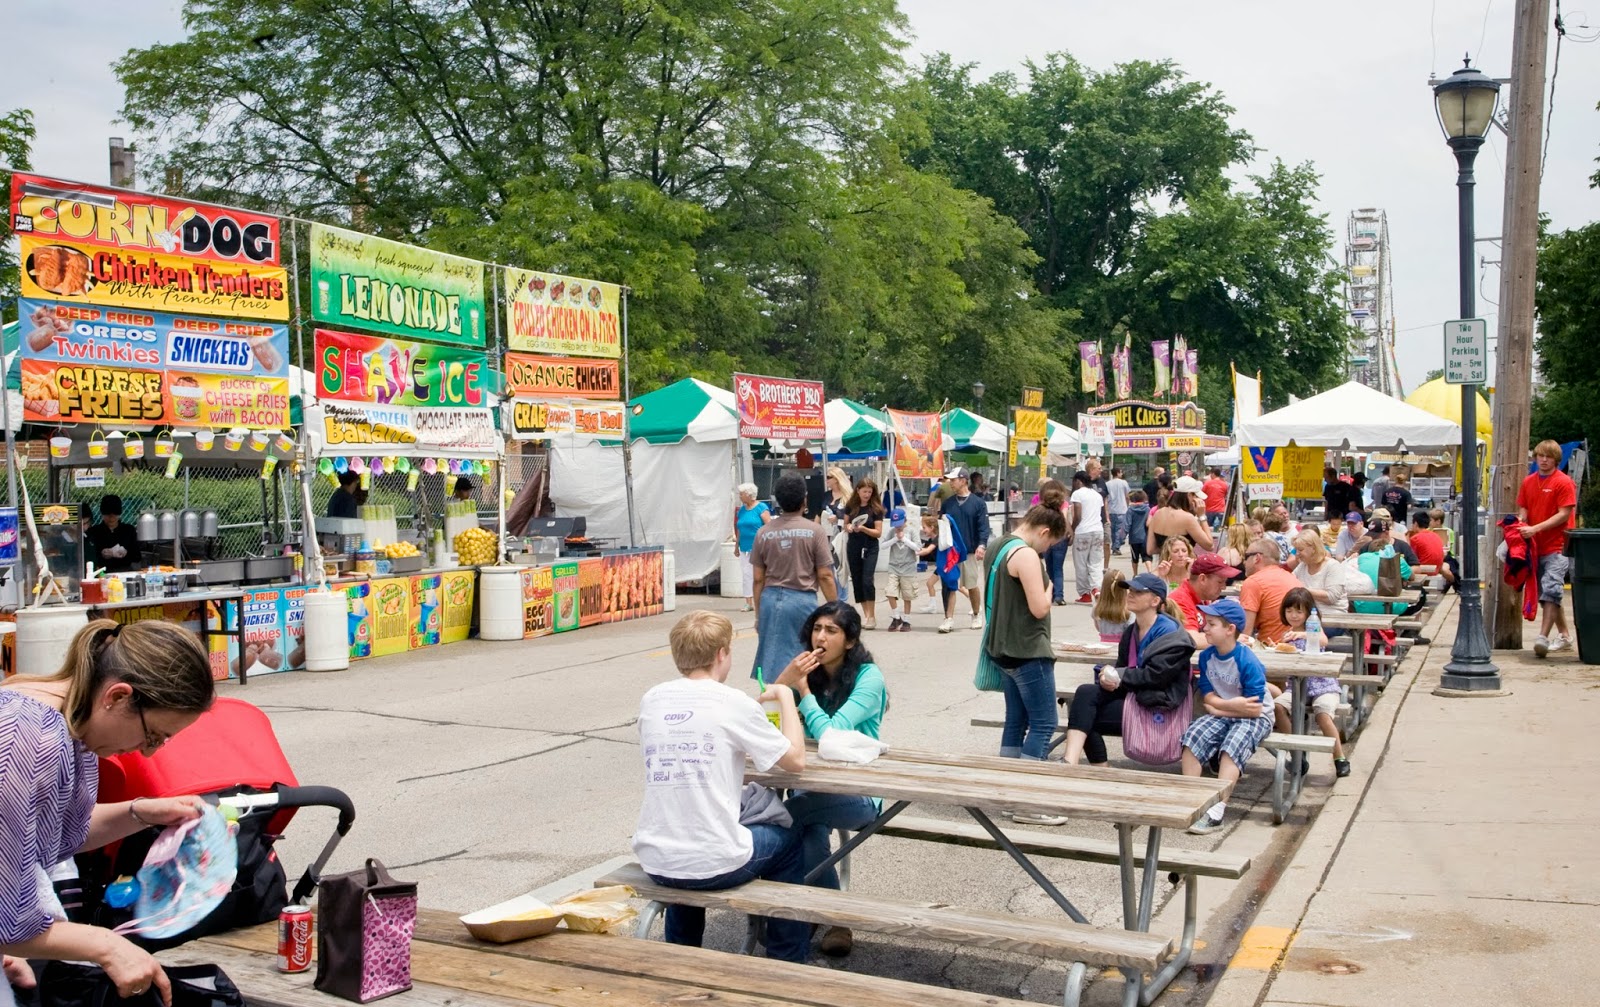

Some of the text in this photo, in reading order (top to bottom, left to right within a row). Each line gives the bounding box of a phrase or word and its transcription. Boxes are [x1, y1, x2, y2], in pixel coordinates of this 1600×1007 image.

[20, 195, 273, 261] CORN DOG
[374, 251, 434, 279] fresh squeezed
[93, 251, 284, 300] Chicken Tenders
[106, 280, 271, 310] With French Fries
[508, 273, 526, 308] JUMBO
[339, 273, 463, 336] LEMONADE
[55, 305, 154, 327] DEEP FRIED
[546, 304, 578, 340] CHICKEN
[579, 308, 590, 342] ON
[75, 324, 157, 342] OREOS
[173, 318, 275, 337] DEEP FRIED
[1459, 324, 1471, 332] Two
[1456, 336, 1474, 344] Hour
[53, 336, 159, 364] Twinkies
[171, 336, 250, 366] SNICKERS
[1452, 347, 1479, 356] Parking
[55, 366, 161, 398] CHEESE
[322, 346, 482, 405] SHAVE ICE
[512, 362, 613, 391] ORANGE CHICKEN
[1449, 371, 1463, 380] Mon
[1471, 371, 1483, 379] Sat
[220, 379, 271, 392] BUCKET OF
[59, 390, 164, 420] FRIES
[205, 391, 287, 409] CHEESE FRIES
[760, 383, 803, 405] BROTHERS'
[804, 387, 822, 410] BBQ
[209, 407, 284, 426] with BACON
[324, 404, 408, 425] Chocolate FROZEN
[416, 411, 462, 430] CHOCOLATE
[514, 402, 547, 430] CRAB
[574, 409, 623, 433] Egg Roll
[1136, 407, 1167, 427] CAKES
[324, 416, 417, 444] Banana
[1132, 439, 1158, 448] FRIES
[1252, 485, 1282, 495] Luke's
[761, 528, 816, 541] VOLUNTEER
[533, 571, 553, 590] CRAB
[255, 591, 279, 602] FRIED
[286, 590, 305, 599] DEEP
[430, 613, 436, 623] 6
[526, 605, 544, 619] EGG
[360, 623, 366, 634] 6
[525, 618, 546, 632] ROLL
[209, 652, 227, 663] RIES
[664, 713, 687, 721] CDW
